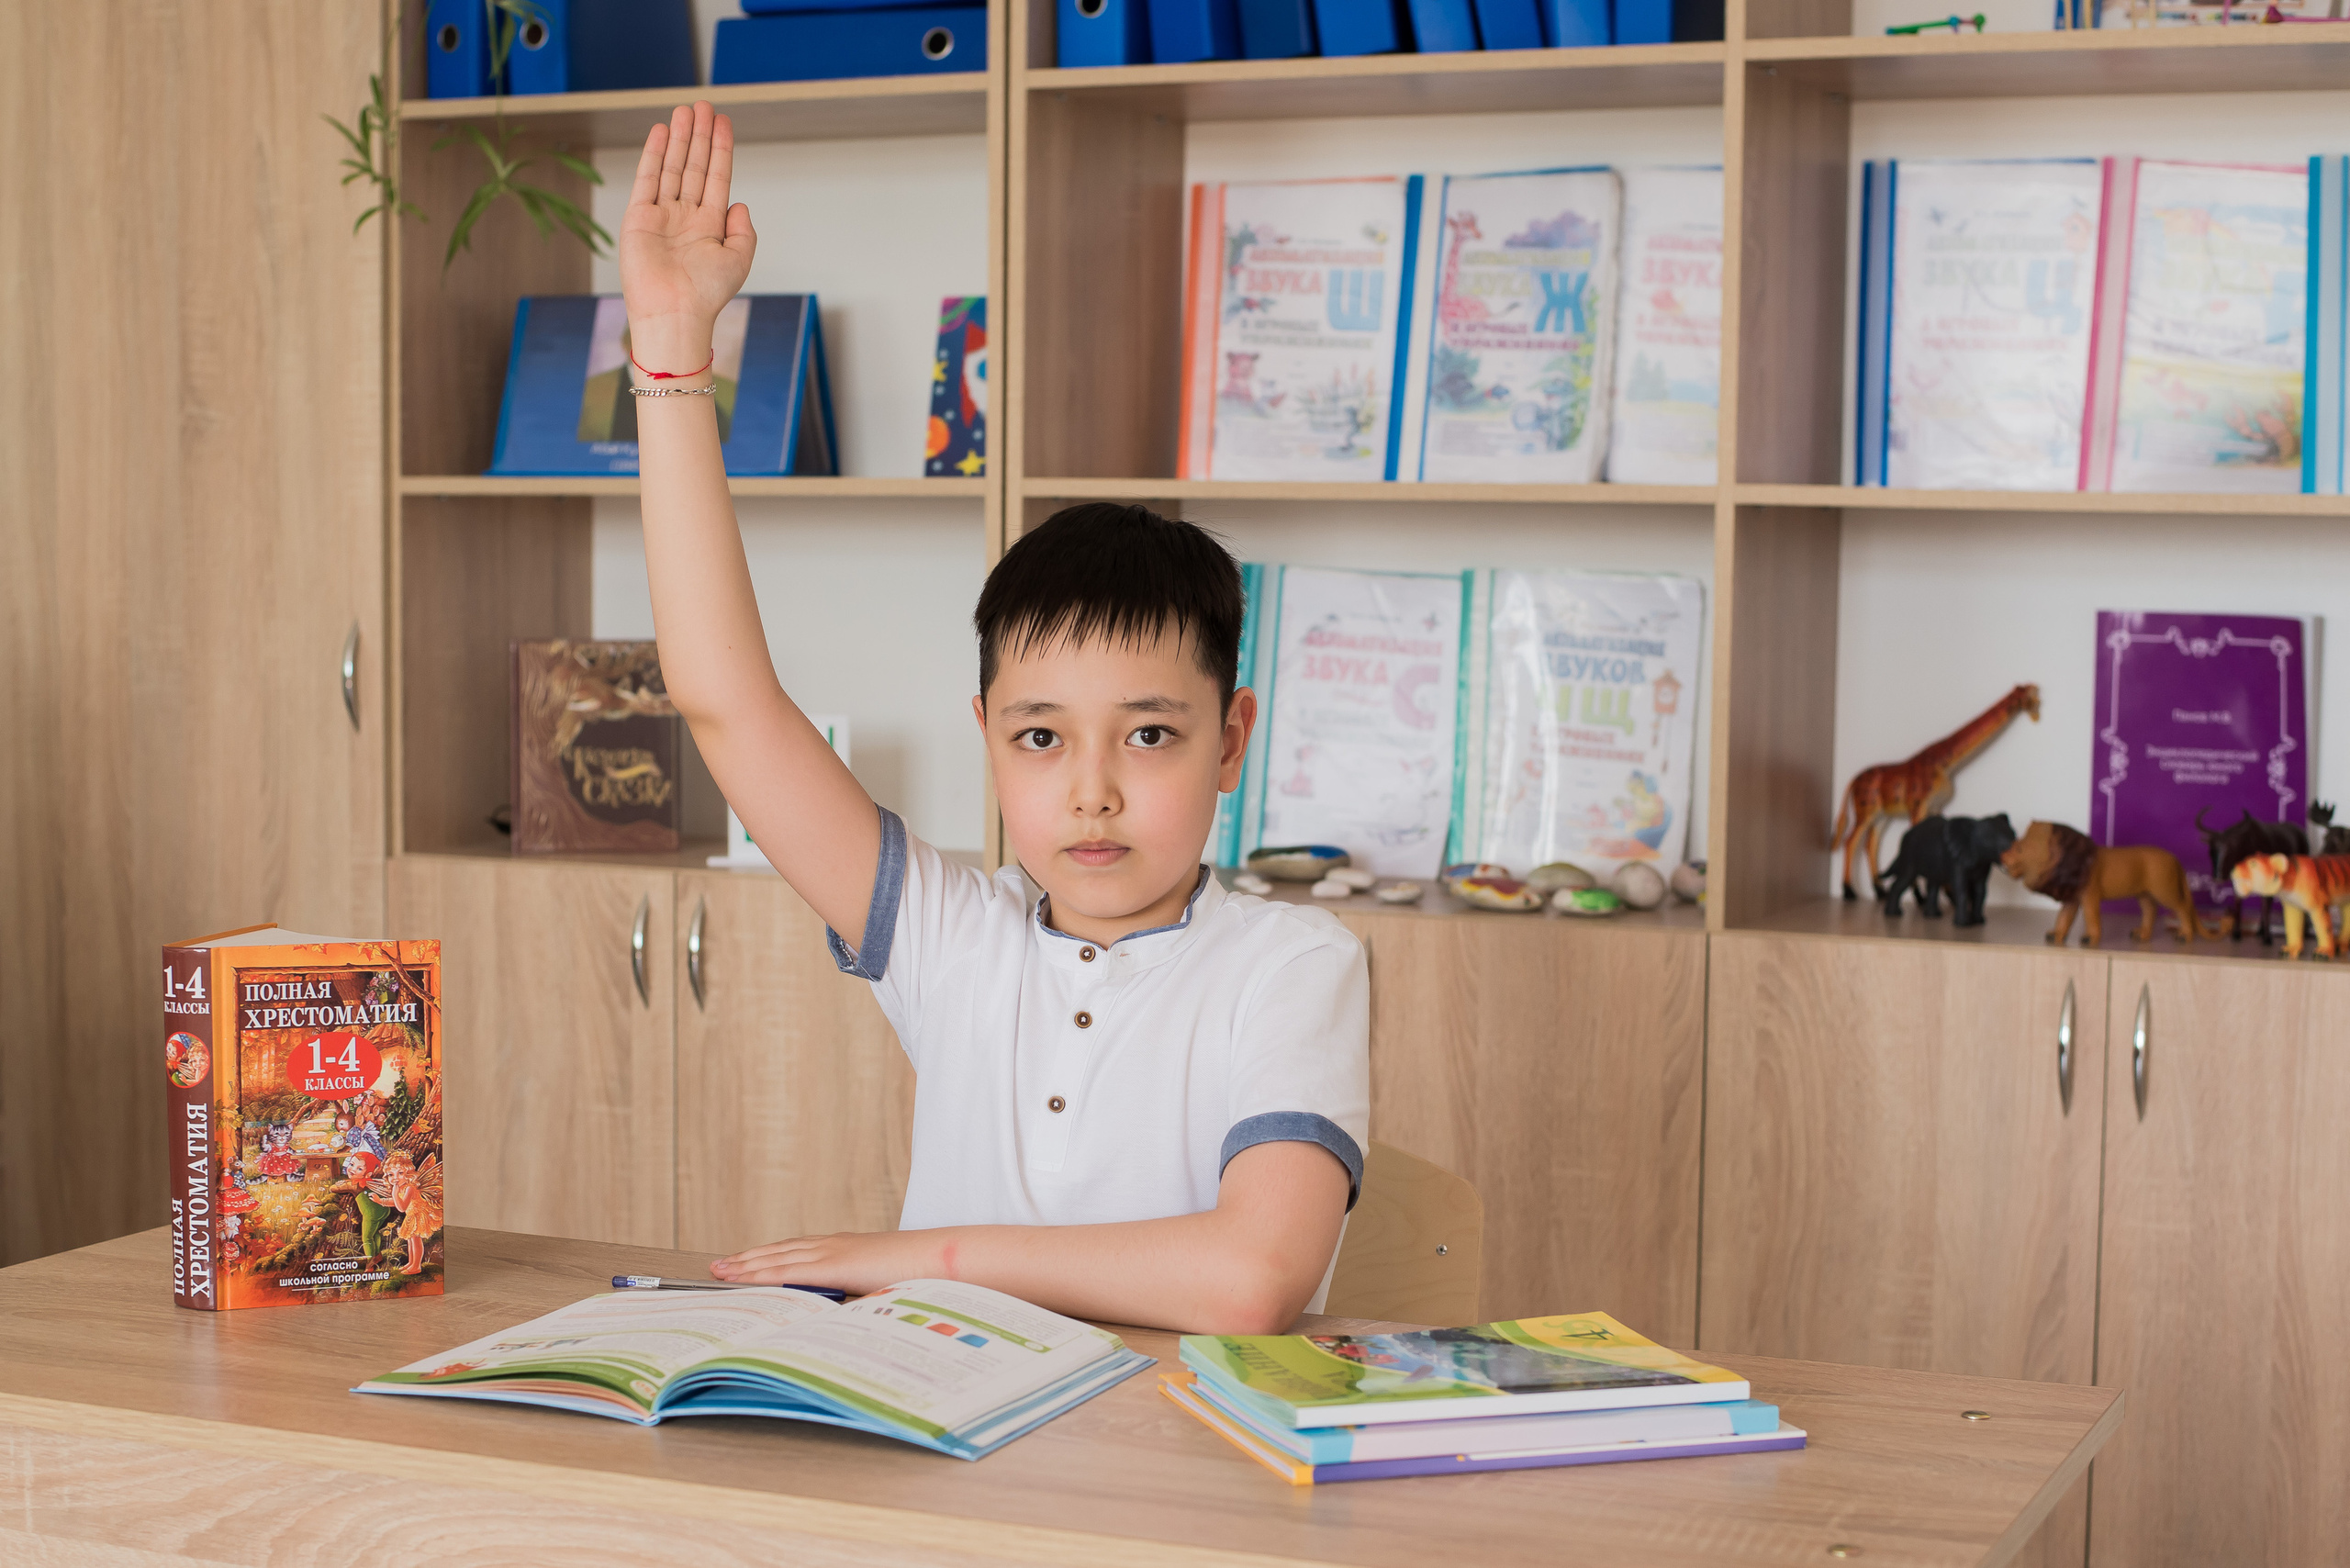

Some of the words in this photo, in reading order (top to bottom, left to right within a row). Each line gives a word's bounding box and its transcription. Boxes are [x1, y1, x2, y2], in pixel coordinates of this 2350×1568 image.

[1327, 269, 1385, 331] Ш
[1534, 271, 1589, 333] Ж
[1303, 655, 1389, 685] ЗВУКА
[1393, 664, 1441, 731] С
[1581, 686, 1635, 736] Щ
[163, 965, 207, 999] 1-4
[244, 981, 332, 1002] ПОЛНАЯ
[163, 1001, 210, 1014] КЛАССЫ
[244, 1002, 418, 1029] ХРЕСТОМАТИЯ
[308, 1036, 361, 1074] 1-4
[304, 1076, 365, 1092] КЛАССЫ
[186, 1103, 210, 1298] ХРЕСТОМАТИЯ
[172, 1197, 185, 1296] ПОЛНАЯ
[279, 1273, 330, 1287] школьной
[331, 1271, 390, 1284] программе
[309, 1260, 359, 1272] согласно
